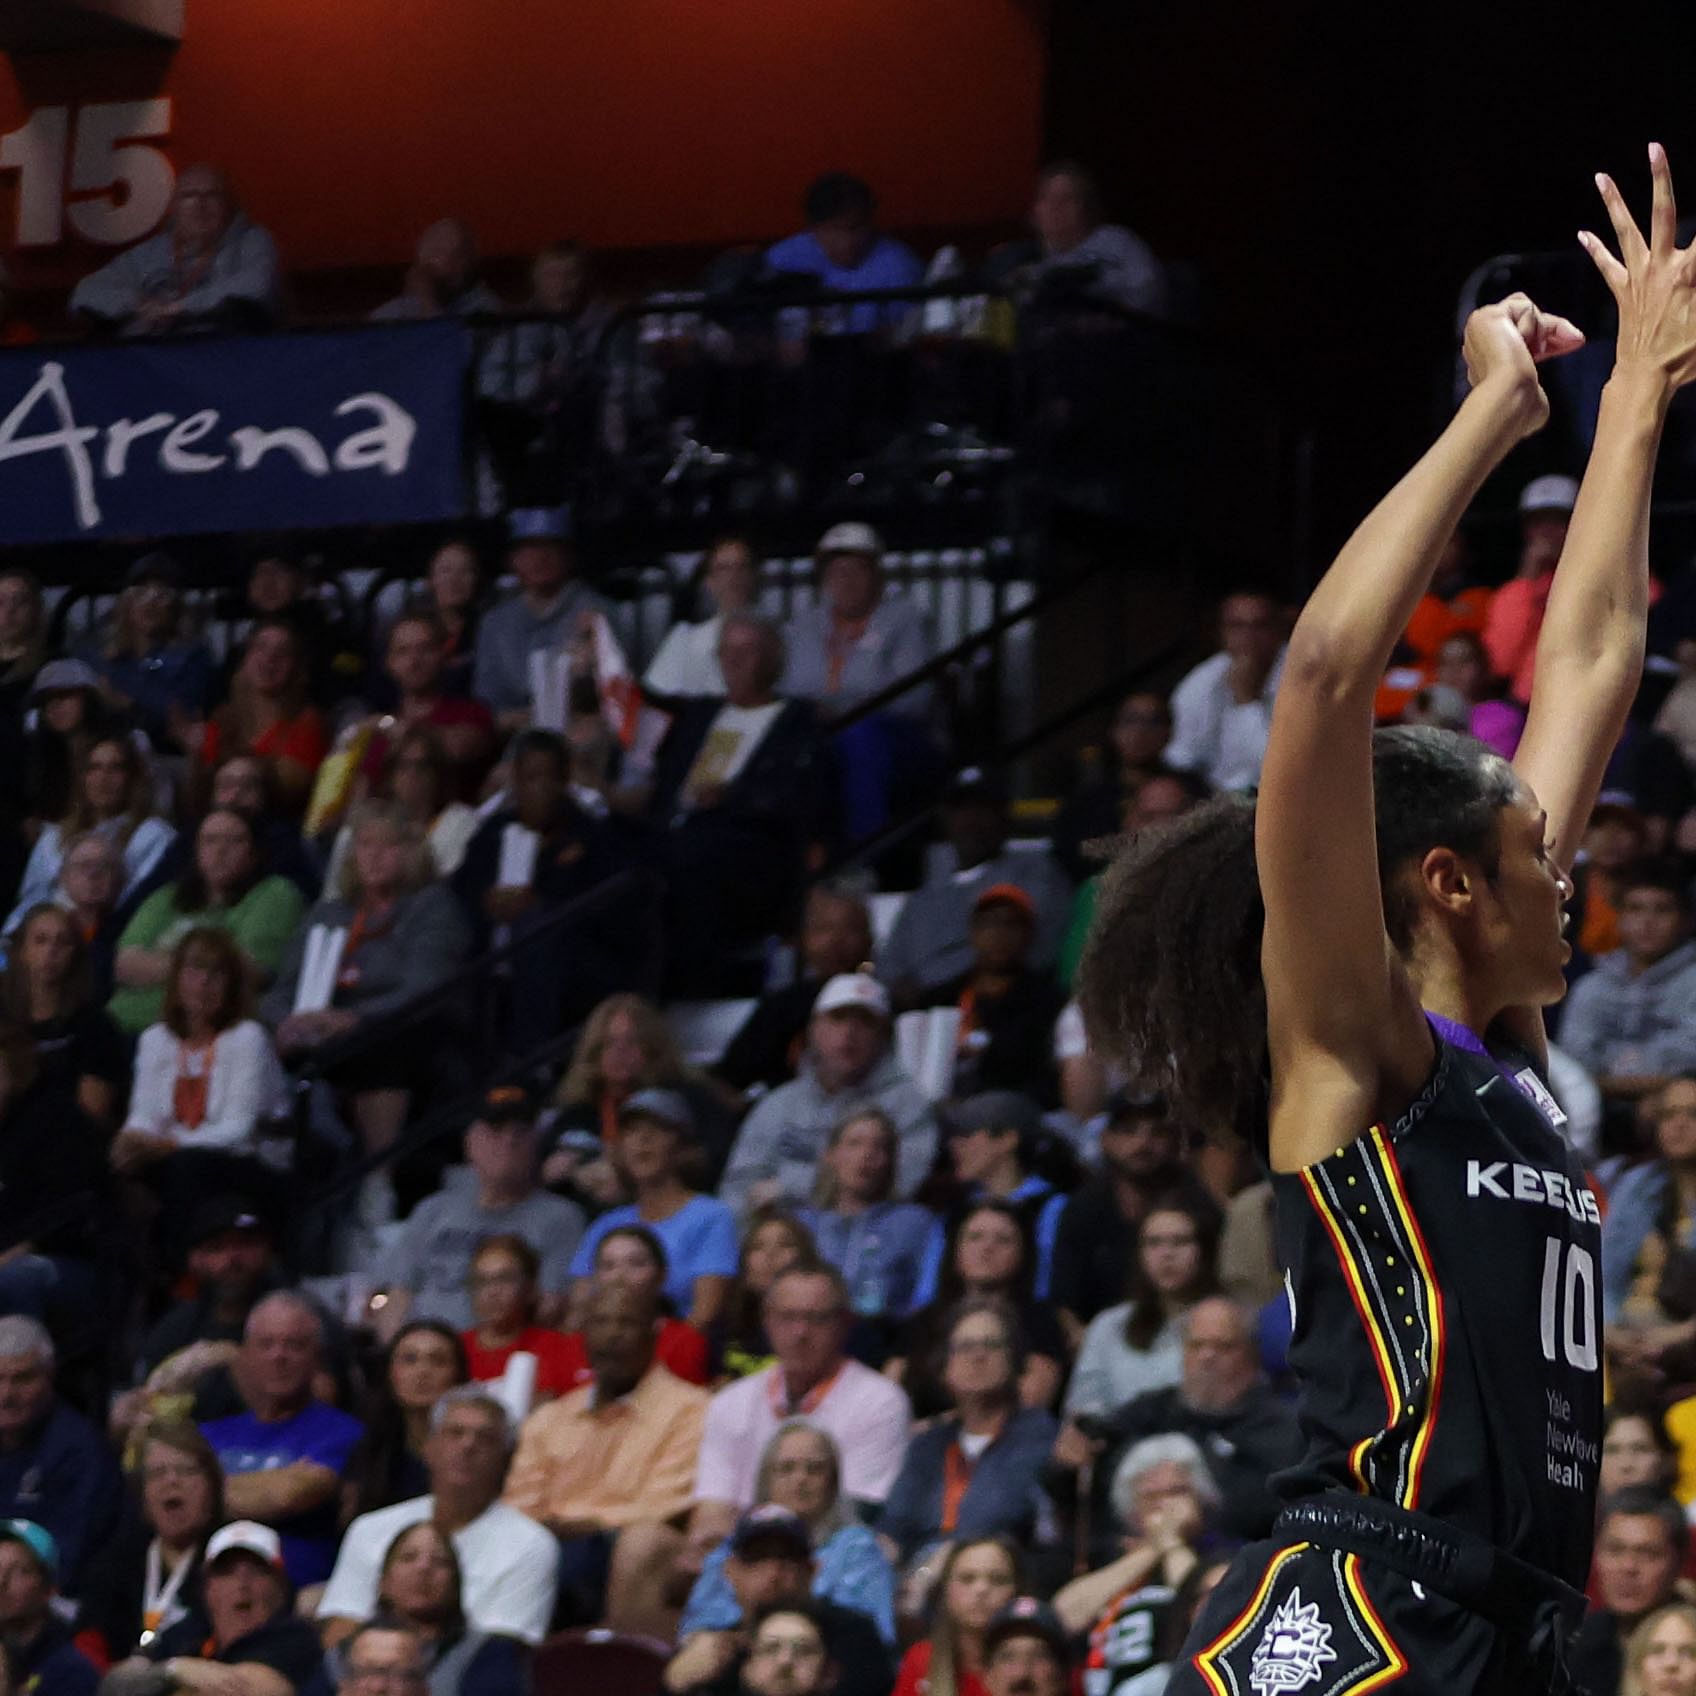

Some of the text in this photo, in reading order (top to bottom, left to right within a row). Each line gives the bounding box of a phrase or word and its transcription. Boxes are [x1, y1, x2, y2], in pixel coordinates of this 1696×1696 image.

[0, 98, 173, 247] 15
[0, 361, 418, 529] Arena
[1541, 1236, 1598, 1372] 10
[1546, 1387, 1571, 1421] Yale
